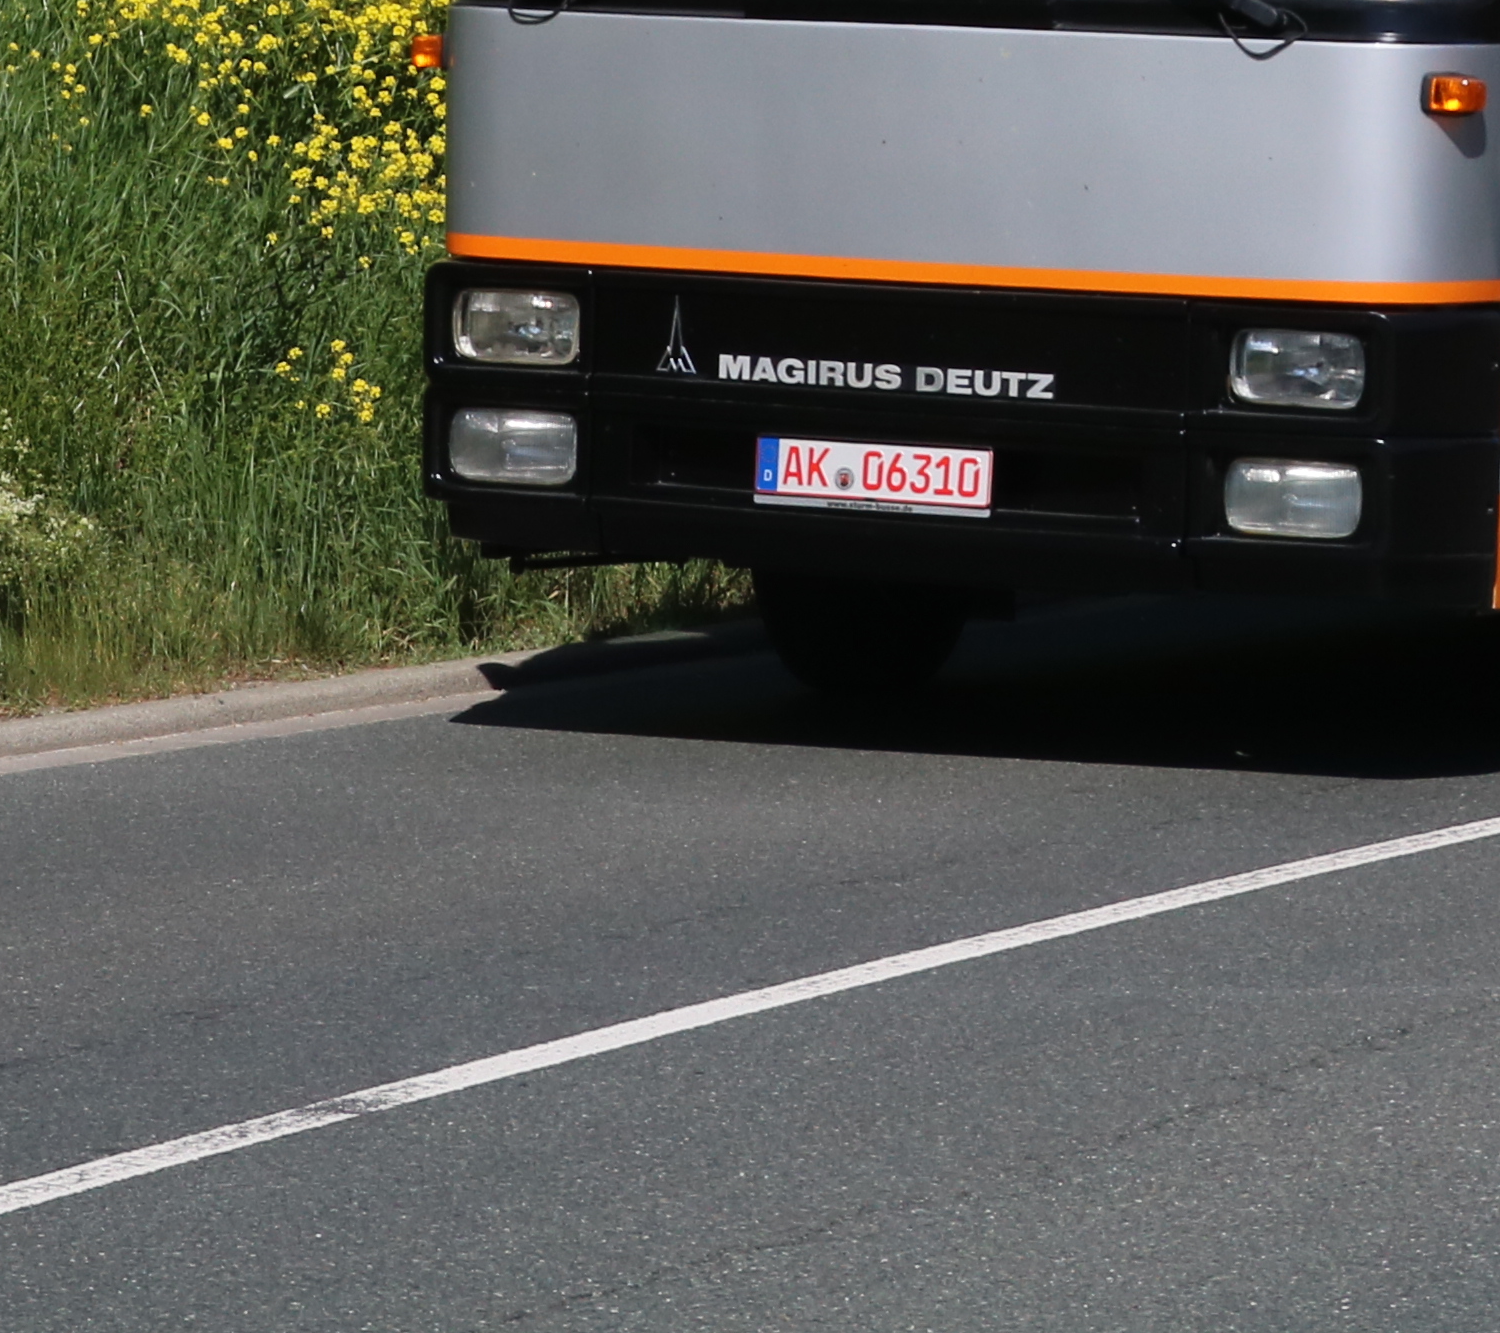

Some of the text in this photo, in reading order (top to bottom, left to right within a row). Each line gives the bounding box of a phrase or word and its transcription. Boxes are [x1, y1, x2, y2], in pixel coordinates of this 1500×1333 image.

[718, 353, 1055, 400] MAGIRUS DEUTZ
[763, 445, 982, 498] D AK 06310
